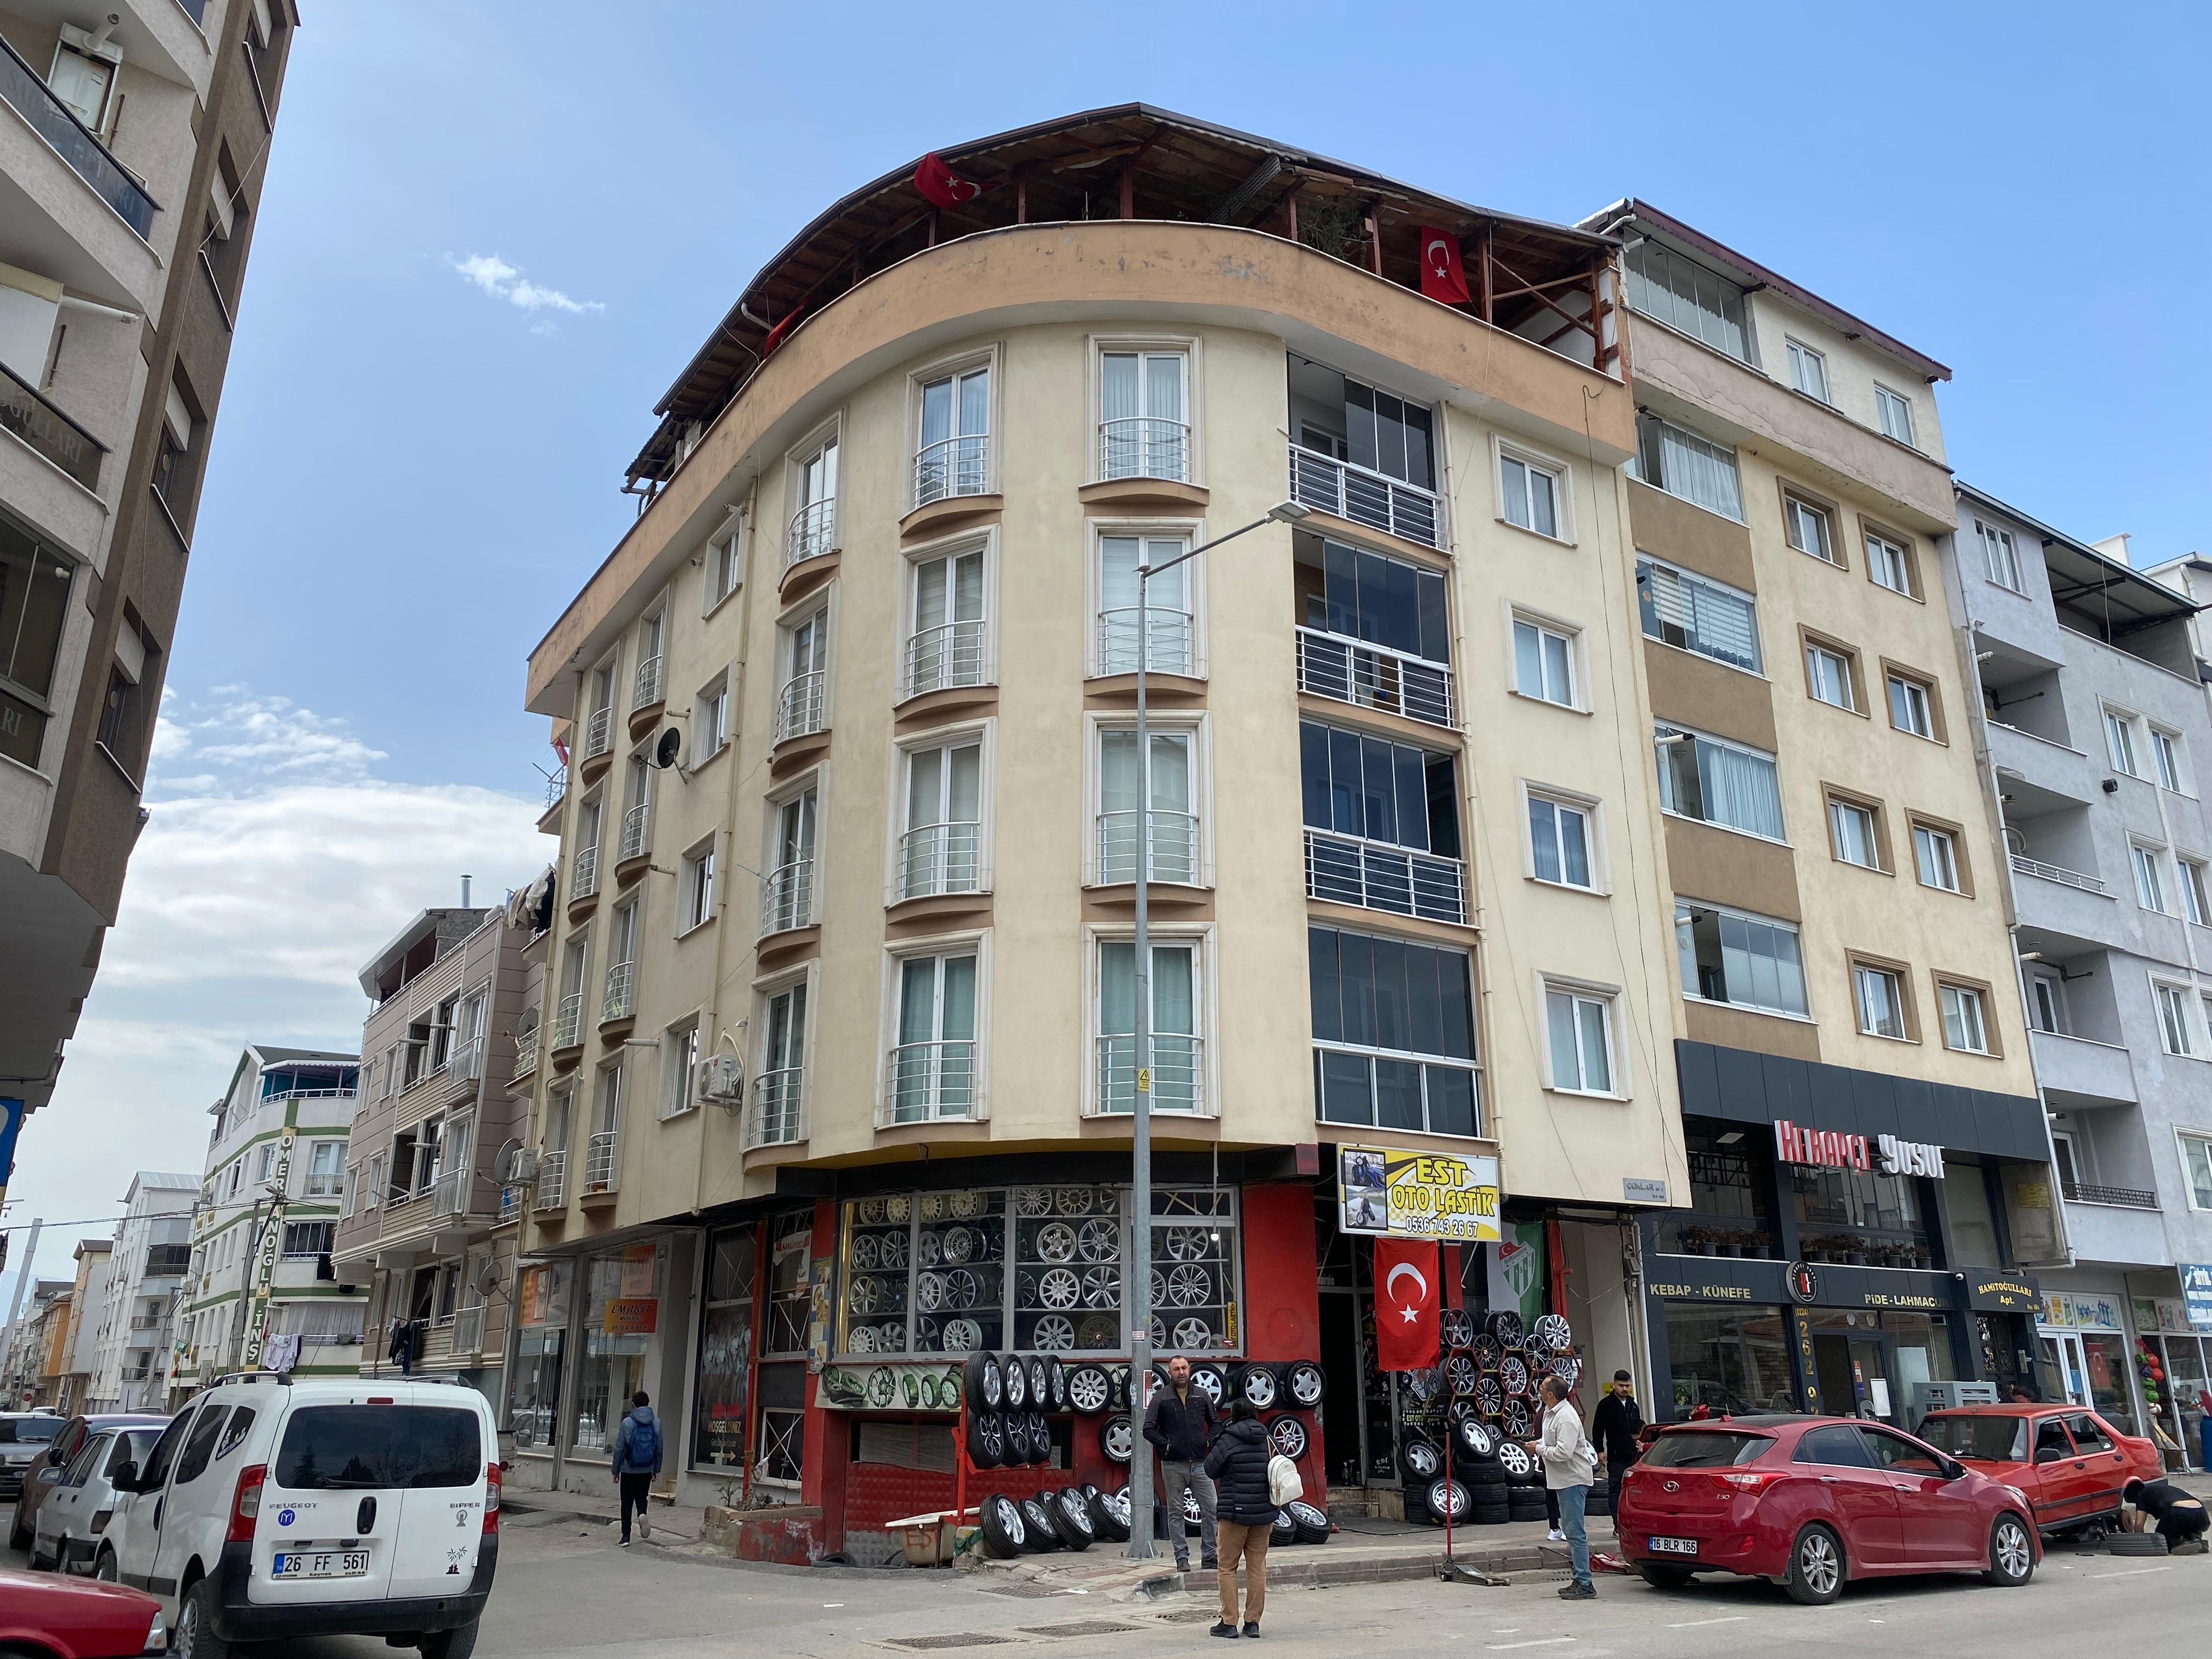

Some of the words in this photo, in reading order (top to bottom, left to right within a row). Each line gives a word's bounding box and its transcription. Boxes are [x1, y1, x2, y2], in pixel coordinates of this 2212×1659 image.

[1774, 1119, 1871, 1176] KEBAPÇI
[1878, 1133, 1945, 1179] YUSUF
[1416, 1158, 1469, 1187] EST
[1392, 1184, 1430, 1211] OTO
[1434, 1188, 1495, 1216] LASTİK
[258, 1132, 292, 1296] ÖMERANOĞLU
[1406, 1216, 1430, 1233] 0536
[1432, 1218, 1450, 1234] 743
[1453, 1220, 1465, 1237] 26
[1466, 1221, 1479, 1237] 67
[1504, 1246, 1527, 1265] BURSASPOR
[1650, 1284, 1691, 1296] KEBAP
[1702, 1285, 1751, 1299] KÜNEFE
[2000, 1295, 2015, 1305] Apt.
[1894, 1295, 1950, 1308] LAHMACUN
[1795, 1308, 1809, 1318] (0224)
[248, 1310, 263, 1360] İNŞ
[1653, 1538, 1661, 1549] 16
[1663, 1539, 1679, 1551] BLR
[1683, 1541, 1696, 1552] 166
[284, 1556, 302, 1572] 26
[314, 1555, 331, 1571] FF
[343, 1554, 365, 1570] 561
